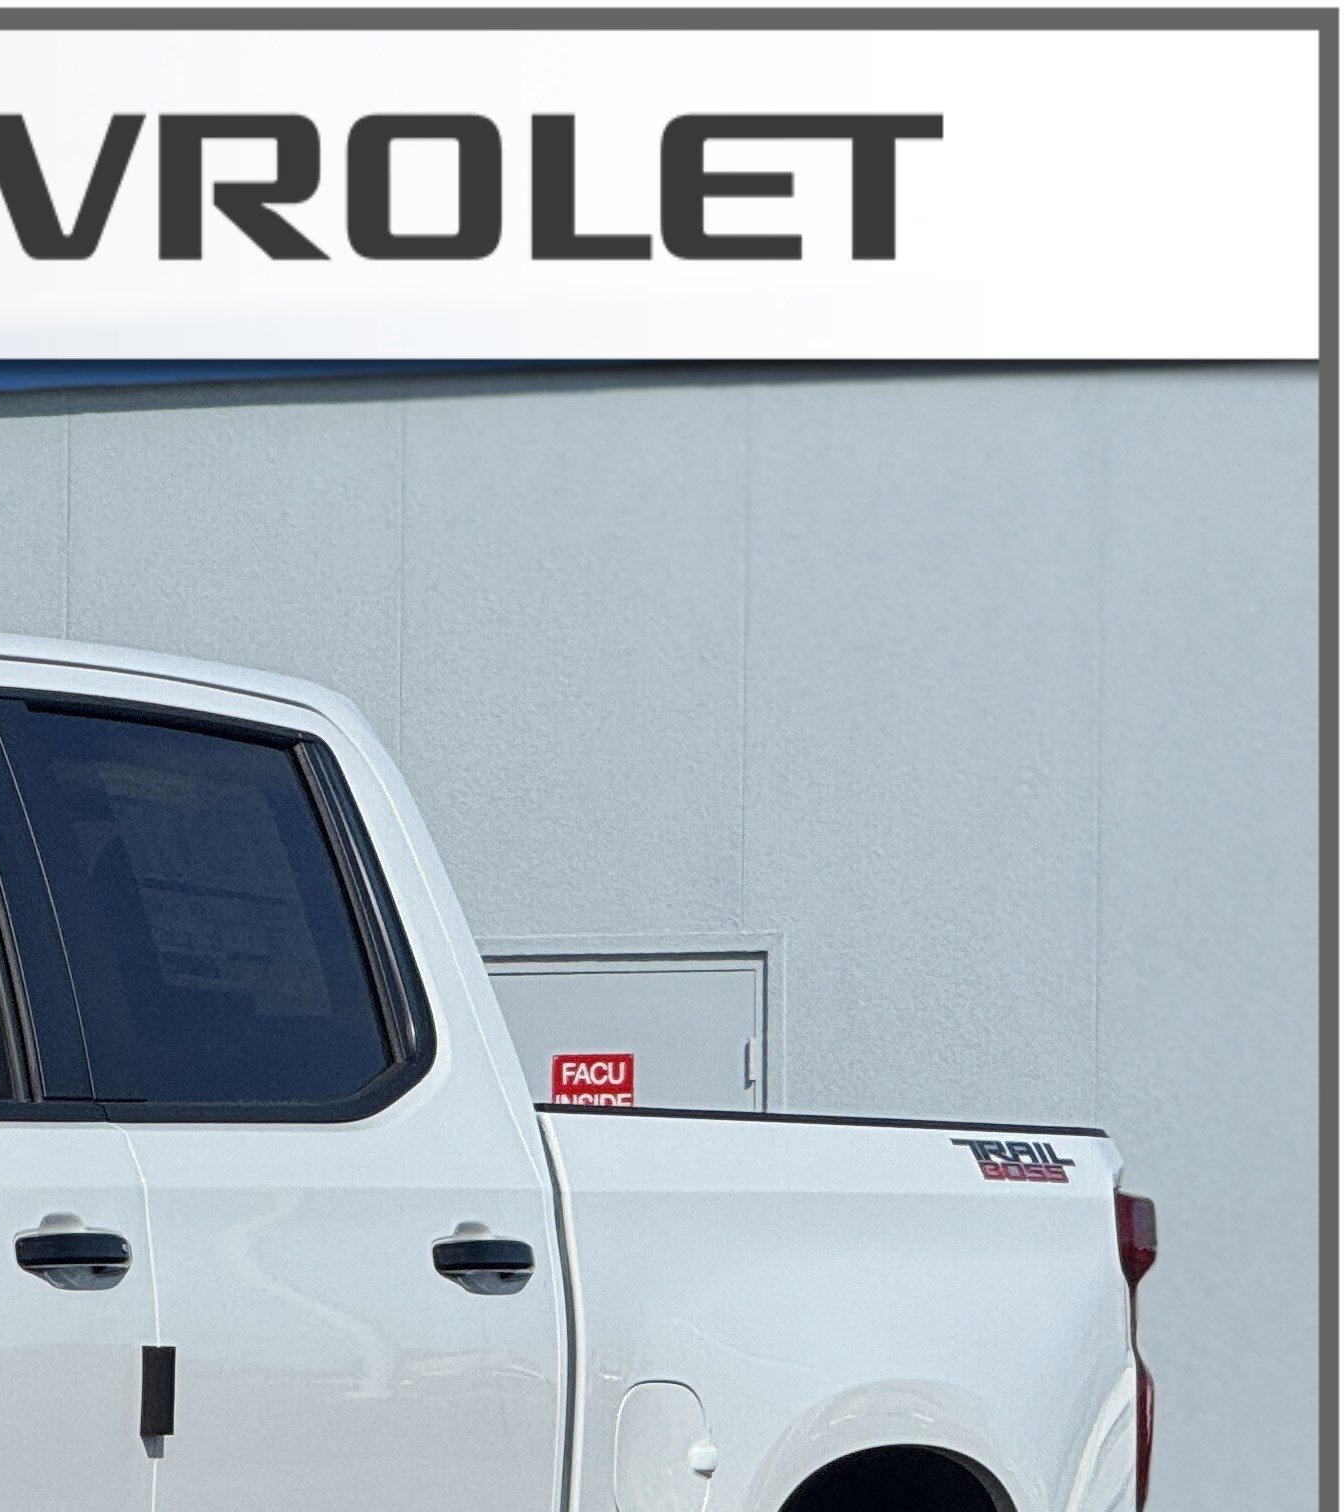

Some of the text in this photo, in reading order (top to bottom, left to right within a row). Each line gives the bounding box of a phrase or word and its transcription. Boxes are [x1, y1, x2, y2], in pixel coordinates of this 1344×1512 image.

[562, 1062, 626, 1085] FACU
[949, 1138, 1076, 1167] TRAIL
[979, 1162, 1069, 1183] BOSS
